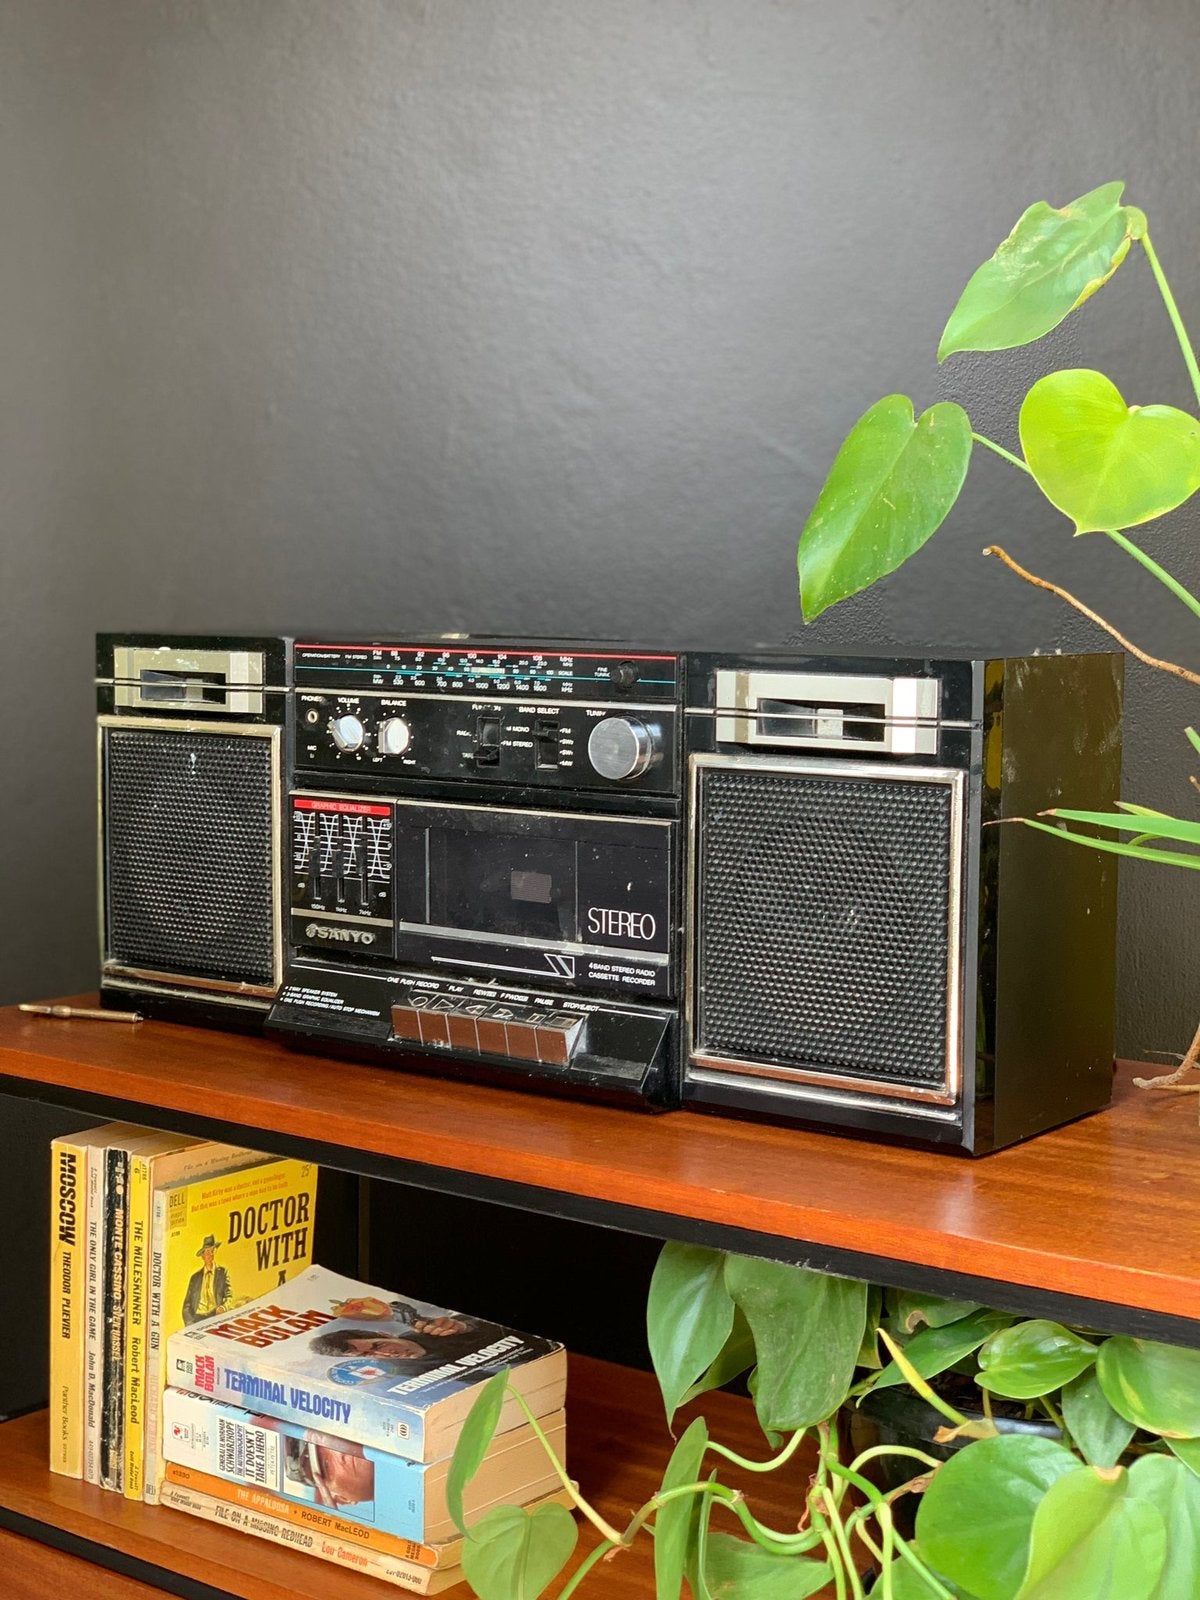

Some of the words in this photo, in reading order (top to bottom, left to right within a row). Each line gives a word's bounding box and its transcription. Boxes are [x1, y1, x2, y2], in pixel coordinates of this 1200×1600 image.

[537, 706, 560, 714] SELECT
[311, 801, 337, 810] GRAPHIC
[338, 803, 371, 813] EQUALIZER
[316, 928, 374, 944] SANYO
[588, 907, 656, 940] STEREO
[588, 972, 619, 982] CASSETTE
[622, 976, 656, 986] RECORDER
[612, 965, 635, 974] STEREO
[636, 968, 656, 977] RADIO
[416, 980, 440, 989] RECORD
[534, 997, 554, 1006] PAUSE
[58, 1152, 76, 1246] MOSCOW
[169, 1191, 185, 1208] DELL
[113, 1208, 124, 1251] MONTE
[134, 1220, 143, 1241] THE
[228, 1192, 310, 1244] DOCTOR
[256, 1227, 308, 1271] WITH
[62, 1252, 72, 1294] THEODOR
[112, 1252, 122, 1300] CASSINO
[132, 1246, 143, 1326] MULESKINNER
[152, 1252, 162, 1287] DOCTOR
[278, 1270, 287, 1287] A
[89, 1285, 96, 1295] IN
[152, 1292, 160, 1318] WITH
[62, 1298, 70, 1339] PLIEVIER
[112, 1304, 122, 1329] SVEN
[205, 1305, 298, 1339] MACK
[234, 1309, 337, 1348] BOLAN
[131, 1337, 141, 1373] Robert
[151, 1331, 159, 1350] GUN
[88, 1351, 96, 1370] John
[195, 1354, 205, 1388] MACK
[205, 1354, 215, 1392] BOLAN
[387, 1362, 468, 1396] TERMINAL
[455, 1335, 524, 1367] VELOCITY
[130, 1376, 140, 1424] MacLeod
[224, 1368, 287, 1406] TERMINAL
[290, 1387, 351, 1424] VELOCITY
[226, 1422, 235, 1473] SCHWARZKOPF
[246, 1430, 255, 1467] DOESN'T
[256, 1430, 265, 1454] HERO
[246, 1468, 255, 1477] IT
[256, 1462, 265, 1482] TAKE
[252, 1494, 289, 1514] APPALOOSA
[301, 1511, 331, 1527] ROBERT
[335, 1522, 370, 1539] MacLEOD
[215, 1505, 228, 1520] FILE
[231, 1510, 242, 1523] ON
[243, 1515, 248, 1527] A
[250, 1517, 280, 1537] MISSING
[281, 1528, 313, 1548] REDHEAD
[322, 1541, 336, 1555] Lou
[337, 1547, 368, 1567] Cameron
